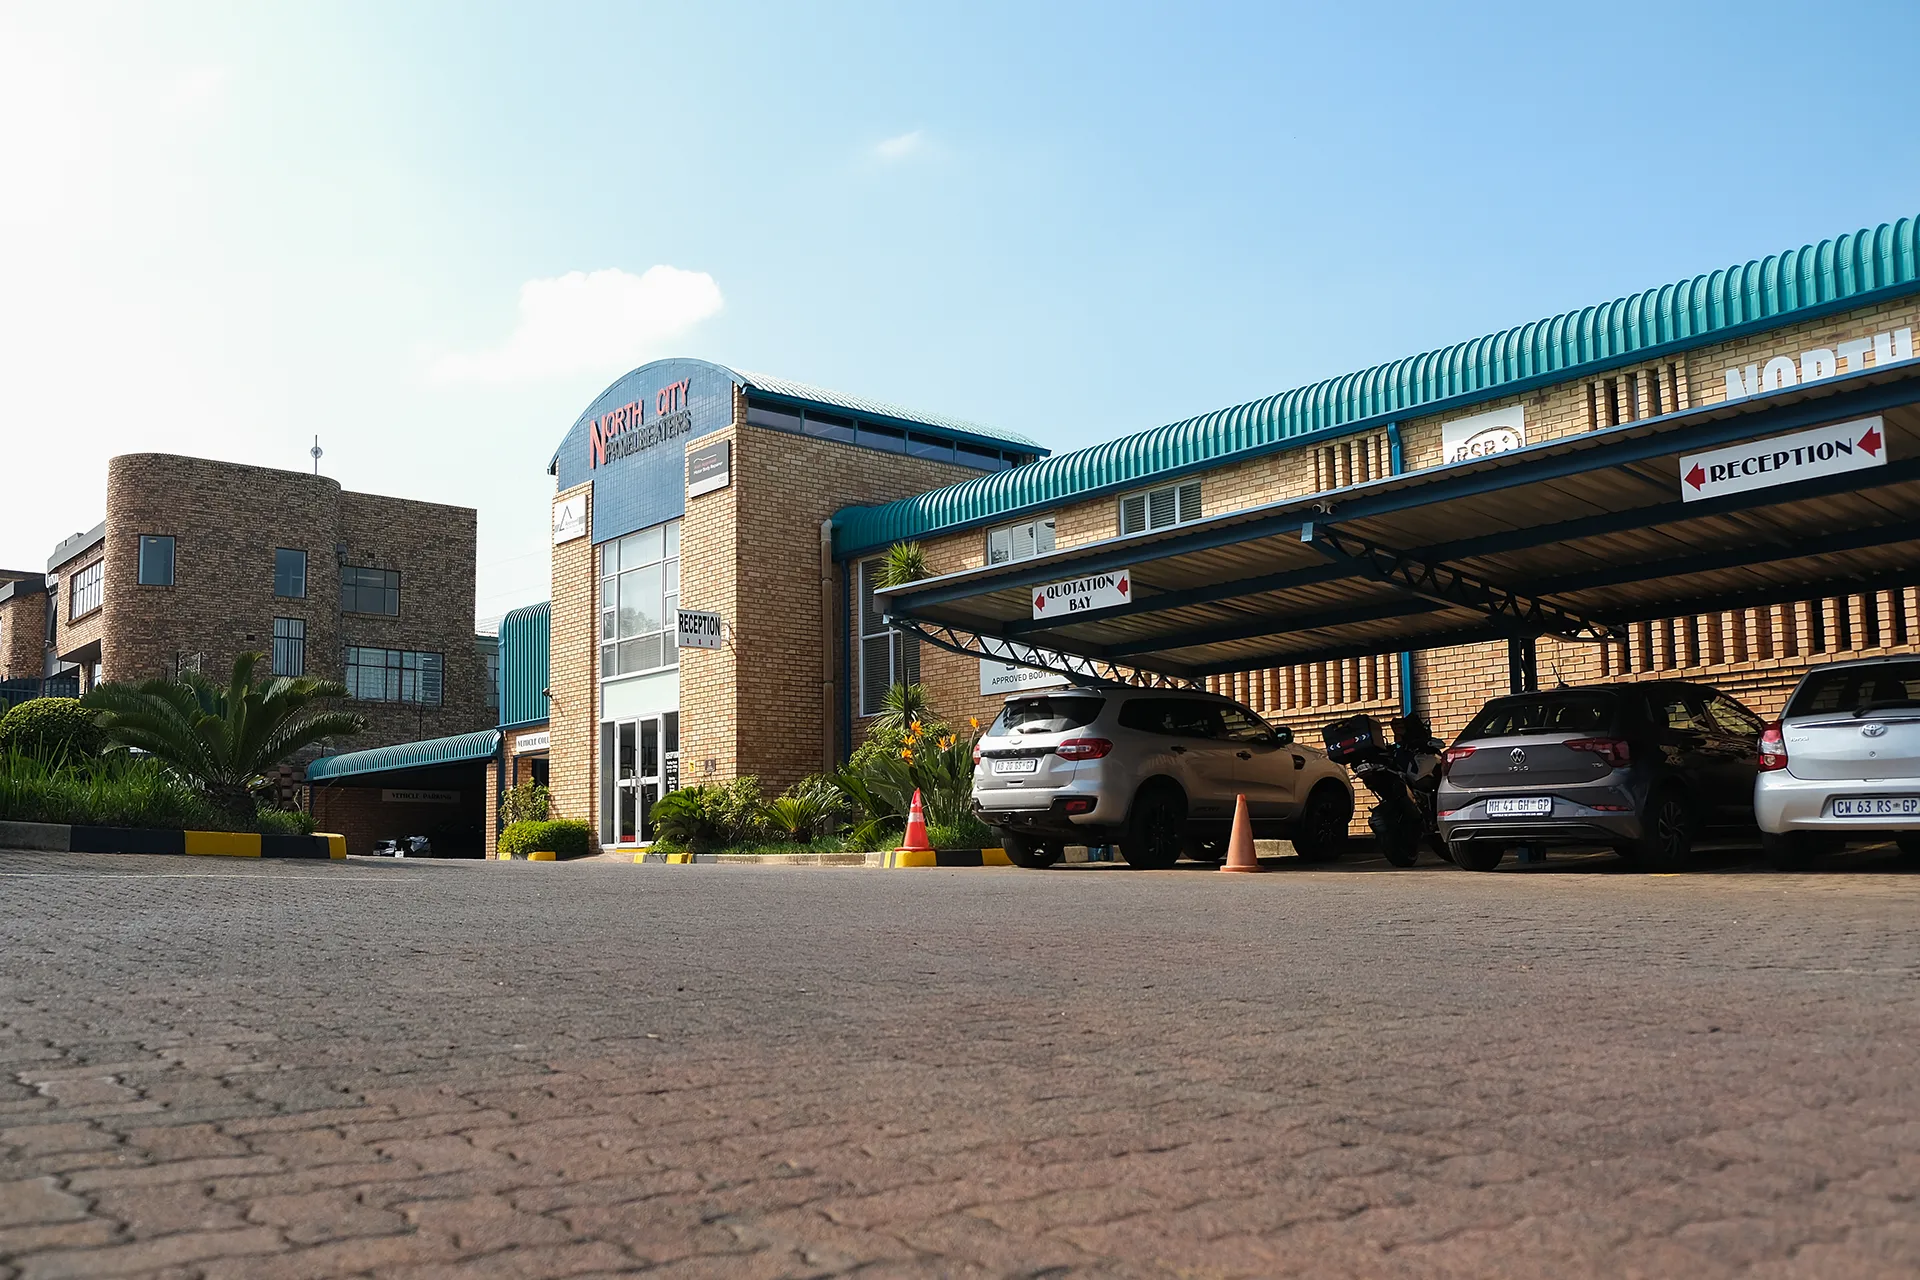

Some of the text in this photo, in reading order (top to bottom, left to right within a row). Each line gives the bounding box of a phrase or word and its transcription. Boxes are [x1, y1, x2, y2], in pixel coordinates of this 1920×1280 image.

[590, 377, 690, 469] NORTH CITY
[1710, 438, 1853, 482] RECEPTION
[1047, 574, 1115, 599] QUOTATION
[1069, 596, 1092, 611] BAY
[679, 613, 720, 636] RECEPTION
[992, 673, 1027, 686] APPROVED
[1029, 670, 1047, 680] BODY
[1503, 800, 1514, 811] 41
[1518, 800, 1529, 810] GH
[1537, 799, 1549, 810] GP
[1837, 799, 1918, 814] CW 63 RS GP
